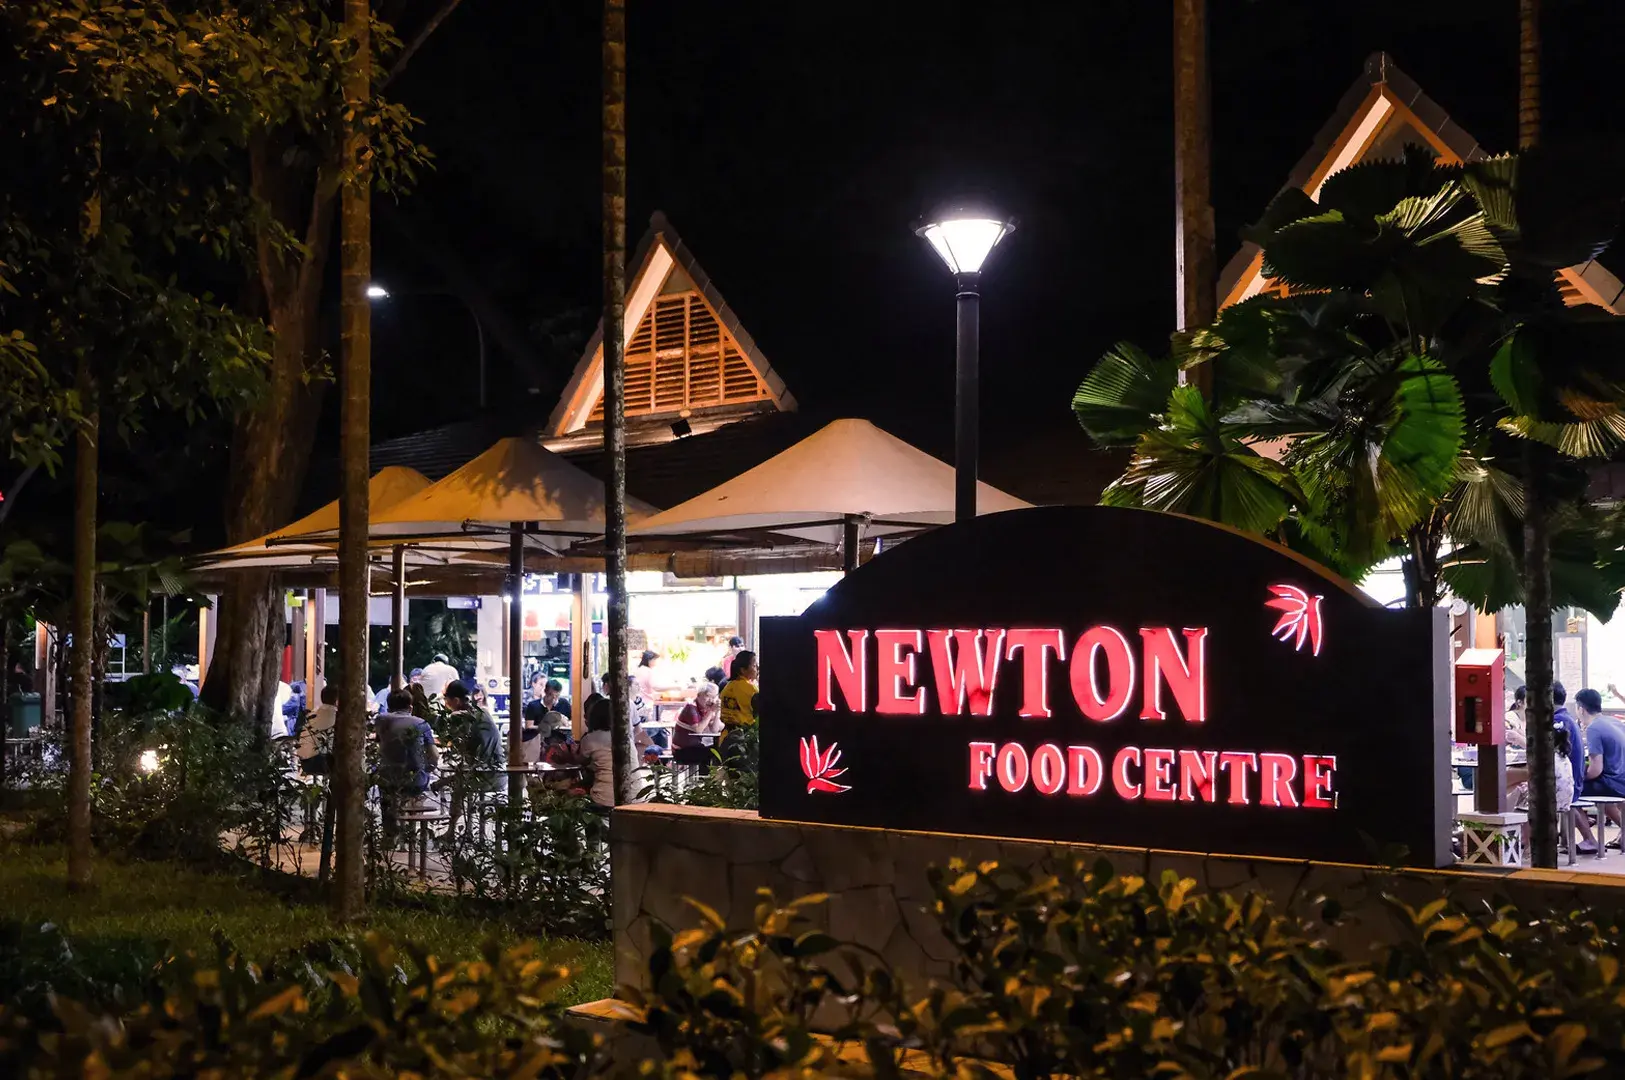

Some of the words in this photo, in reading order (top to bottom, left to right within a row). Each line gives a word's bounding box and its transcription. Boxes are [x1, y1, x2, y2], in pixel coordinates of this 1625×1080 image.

[814, 626, 1208, 722] NEWTON
[968, 741, 1103, 796] FOOD
[1112, 745, 1339, 809] CENTRE
